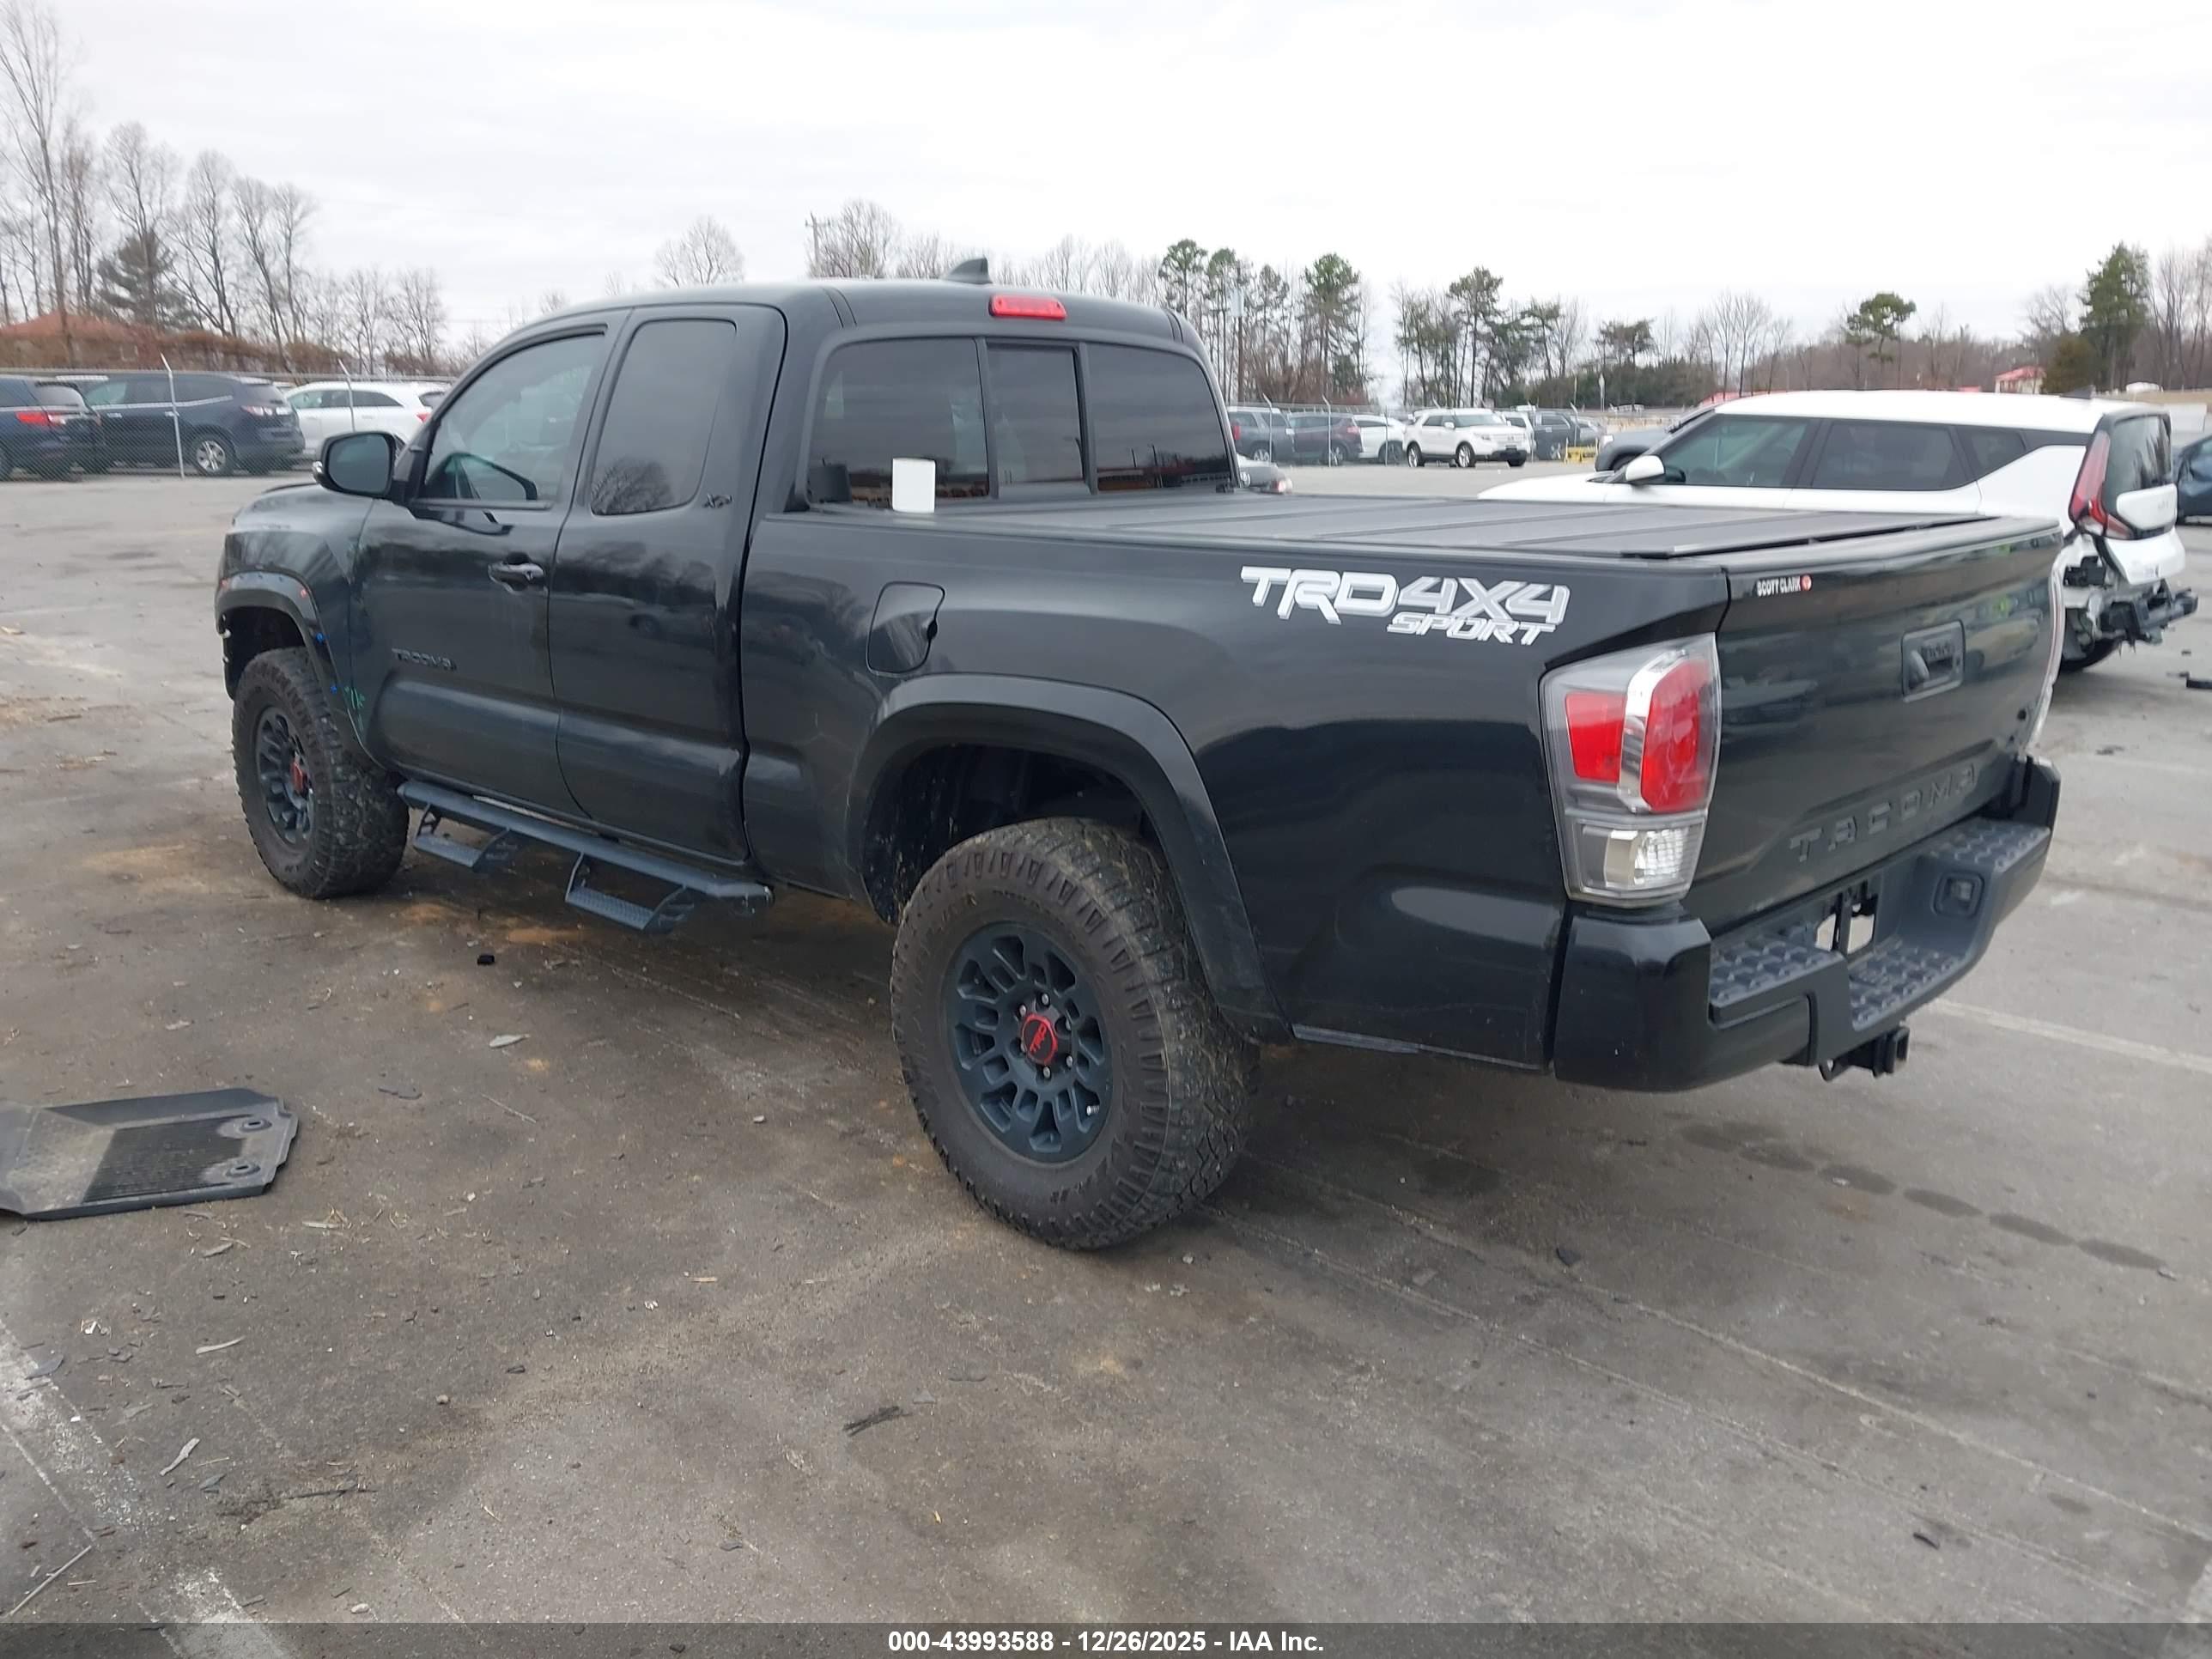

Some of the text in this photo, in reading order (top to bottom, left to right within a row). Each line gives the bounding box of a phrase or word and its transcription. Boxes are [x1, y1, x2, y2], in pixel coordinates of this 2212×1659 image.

[1756, 575, 1802, 597] SCOTT CLARK
[1386, 611, 1556, 646] SPORT
[1789, 763, 1978, 862] TACOMA
